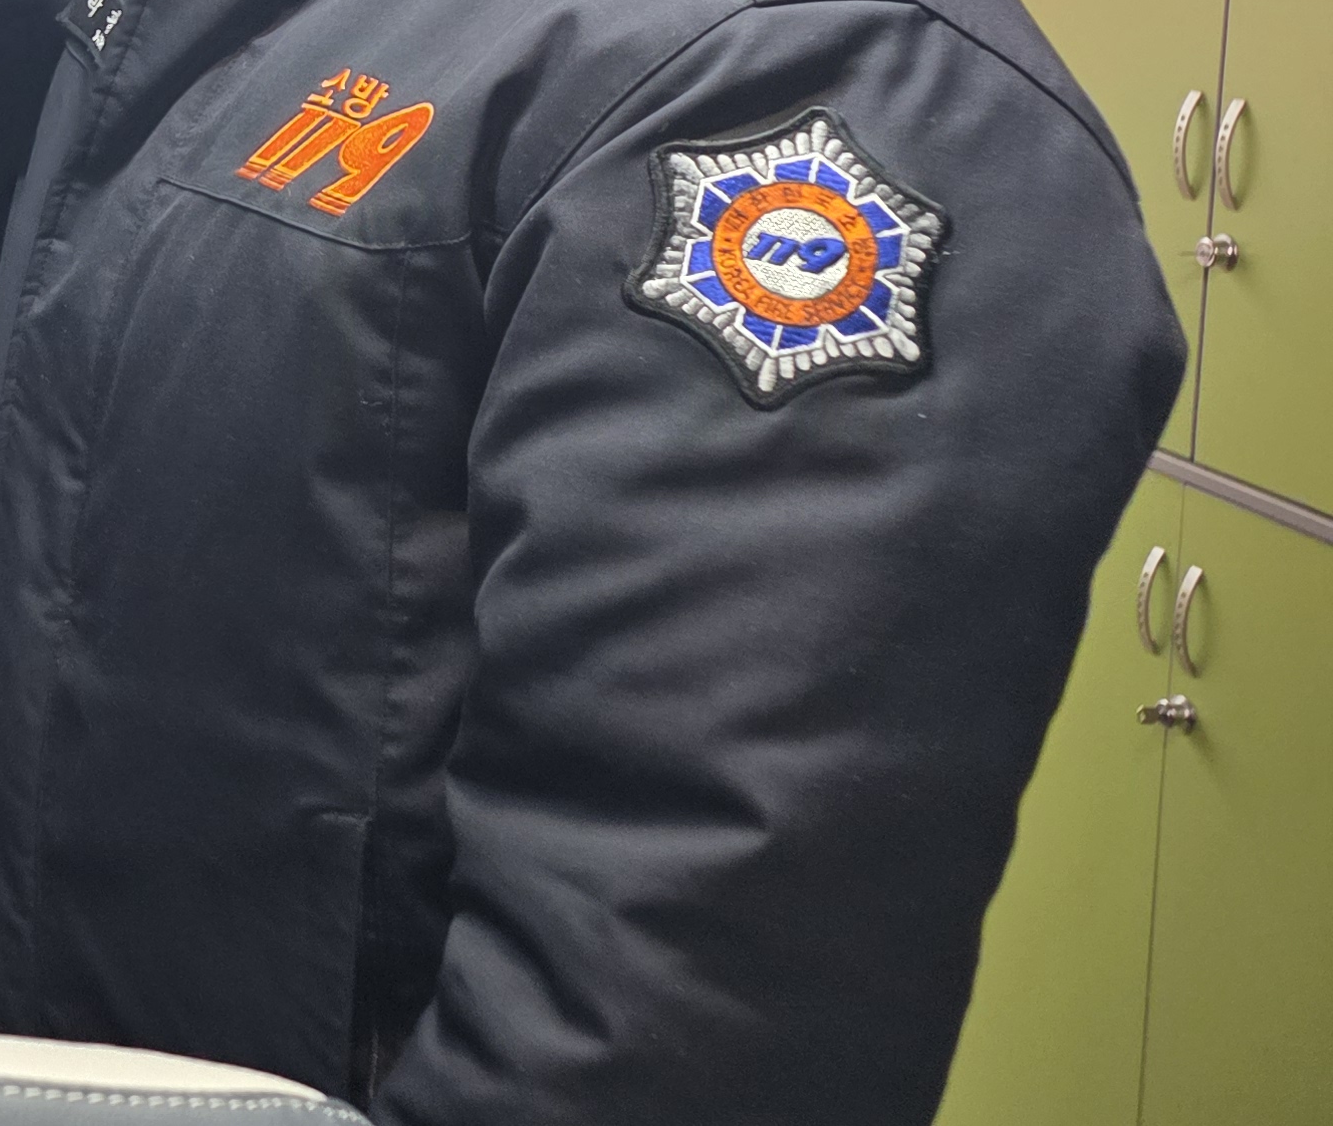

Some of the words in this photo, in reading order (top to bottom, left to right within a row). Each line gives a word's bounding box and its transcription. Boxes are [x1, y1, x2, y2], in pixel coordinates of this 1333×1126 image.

[307, 68, 390, 119] 소방
[236, 102, 434, 217] 119
[745, 231, 848, 275] 119
